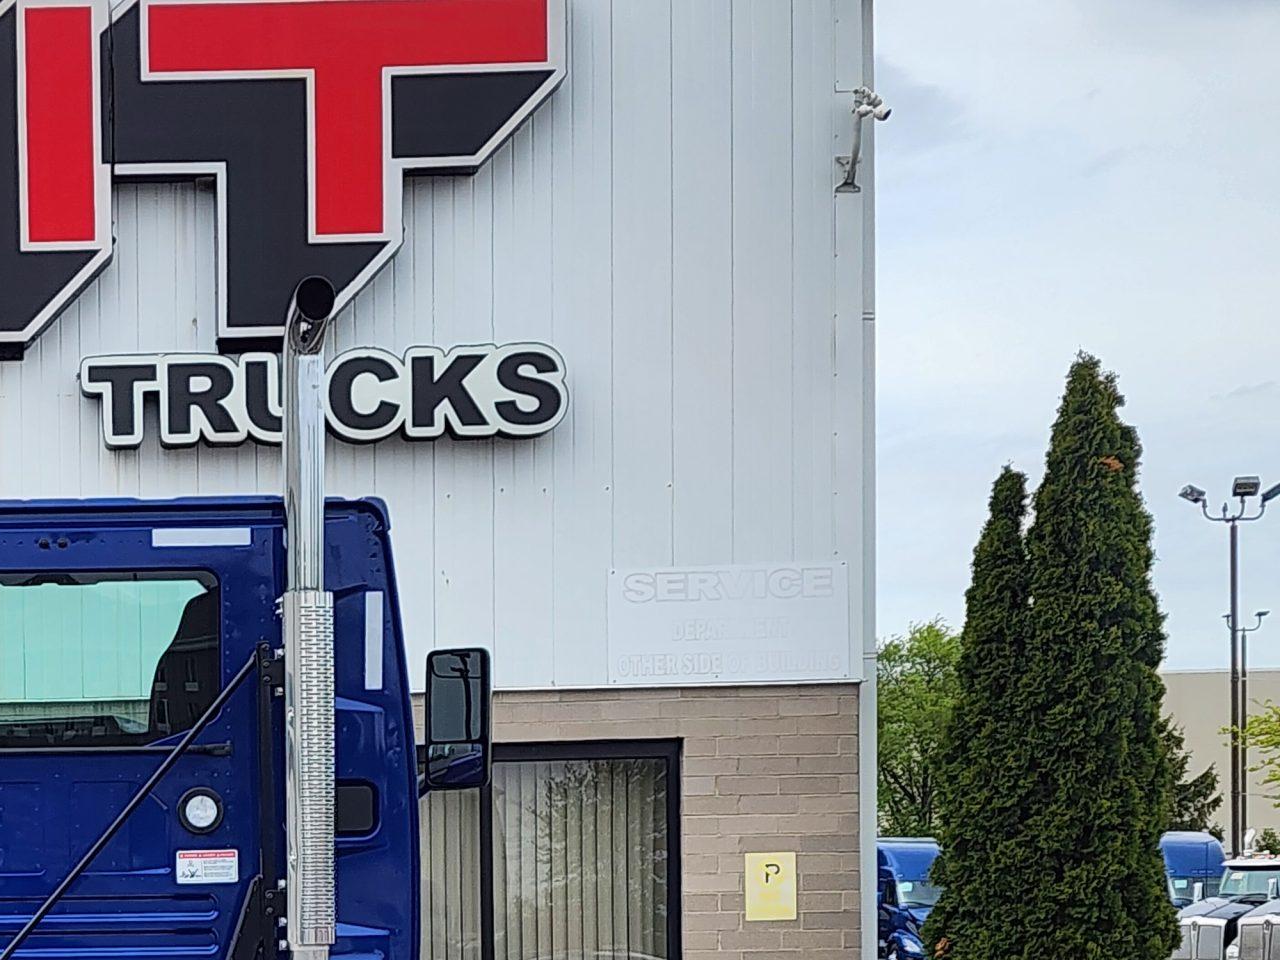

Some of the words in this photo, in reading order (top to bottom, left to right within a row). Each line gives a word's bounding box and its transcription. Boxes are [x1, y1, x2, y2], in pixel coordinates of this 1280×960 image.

[624, 568, 833, 603] SERVICE
[672, 616, 792, 641] DEPARENT
[619, 654, 679, 677] OTHER
[681, 653, 723, 676] SIDE
